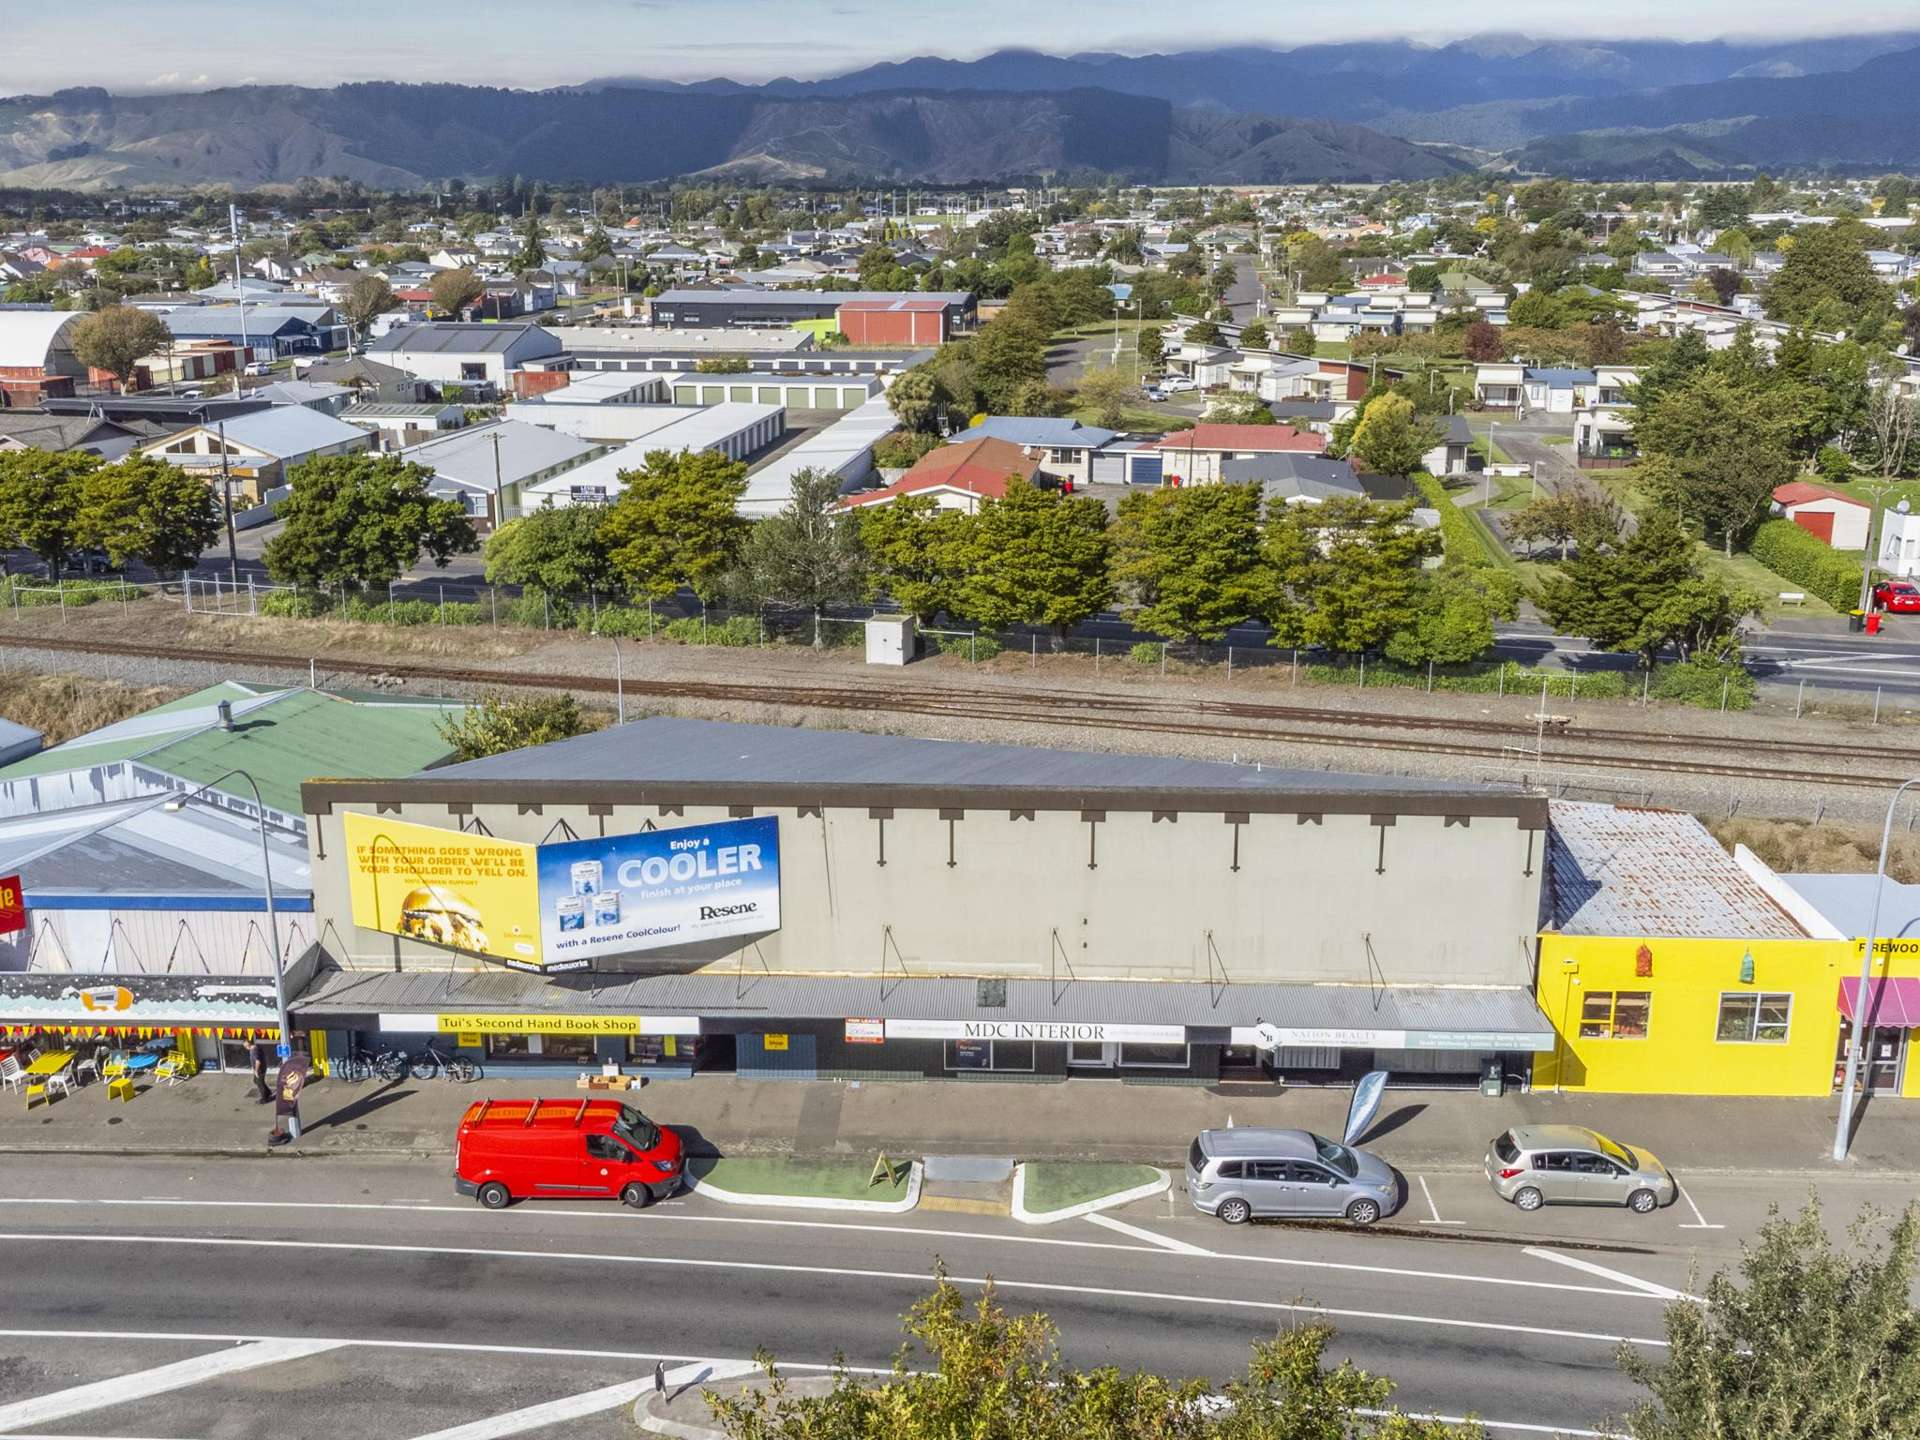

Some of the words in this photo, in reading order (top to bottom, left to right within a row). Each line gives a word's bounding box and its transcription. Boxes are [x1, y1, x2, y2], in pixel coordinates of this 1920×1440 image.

[670, 839, 700, 851] Enjoy
[703, 838, 710, 846] a
[356, 846, 366, 854] IF
[369, 846, 436, 856] SOMETHING
[439, 847, 470, 856] GOES
[474, 848, 523, 857] WRONG
[358, 856, 389, 864] WITH
[393, 856, 424, 865] YOUR
[471, 858, 506, 867] WE'LL
[510, 859, 525, 867] BE
[617, 843, 763, 888] COOLER
[359, 865, 390, 874] YOUR
[393, 866, 453, 876] SHOULDER
[456, 867, 472, 876] TO
[476, 868, 506, 877] YELL
[640, 887, 671, 900] finish
[674, 885, 686, 894] at
[687, 882, 713, 895] your
[714, 878, 742, 891] place
[699, 902, 757, 920] Resene
[556, 938, 579, 949] with
[590, 933, 624, 944] Resene
[626, 924, 681, 939] CoolColour!
[1858, 943, 1919, 953] FREWOO
[443, 1018, 472, 1028] Tui's
[475, 1018, 523, 1029] Second
[527, 1018, 562, 1029] Hand
[566, 1019, 600, 1030] Book
[603, 1019, 637, 1031] Shop
[965, 1023, 1008, 1038] MDC
[1015, 1024, 1105, 1040] INTERIOR
[1291, 1030, 1331, 1039] NATION
[1335, 1031, 1377, 1039] BEAUTY
